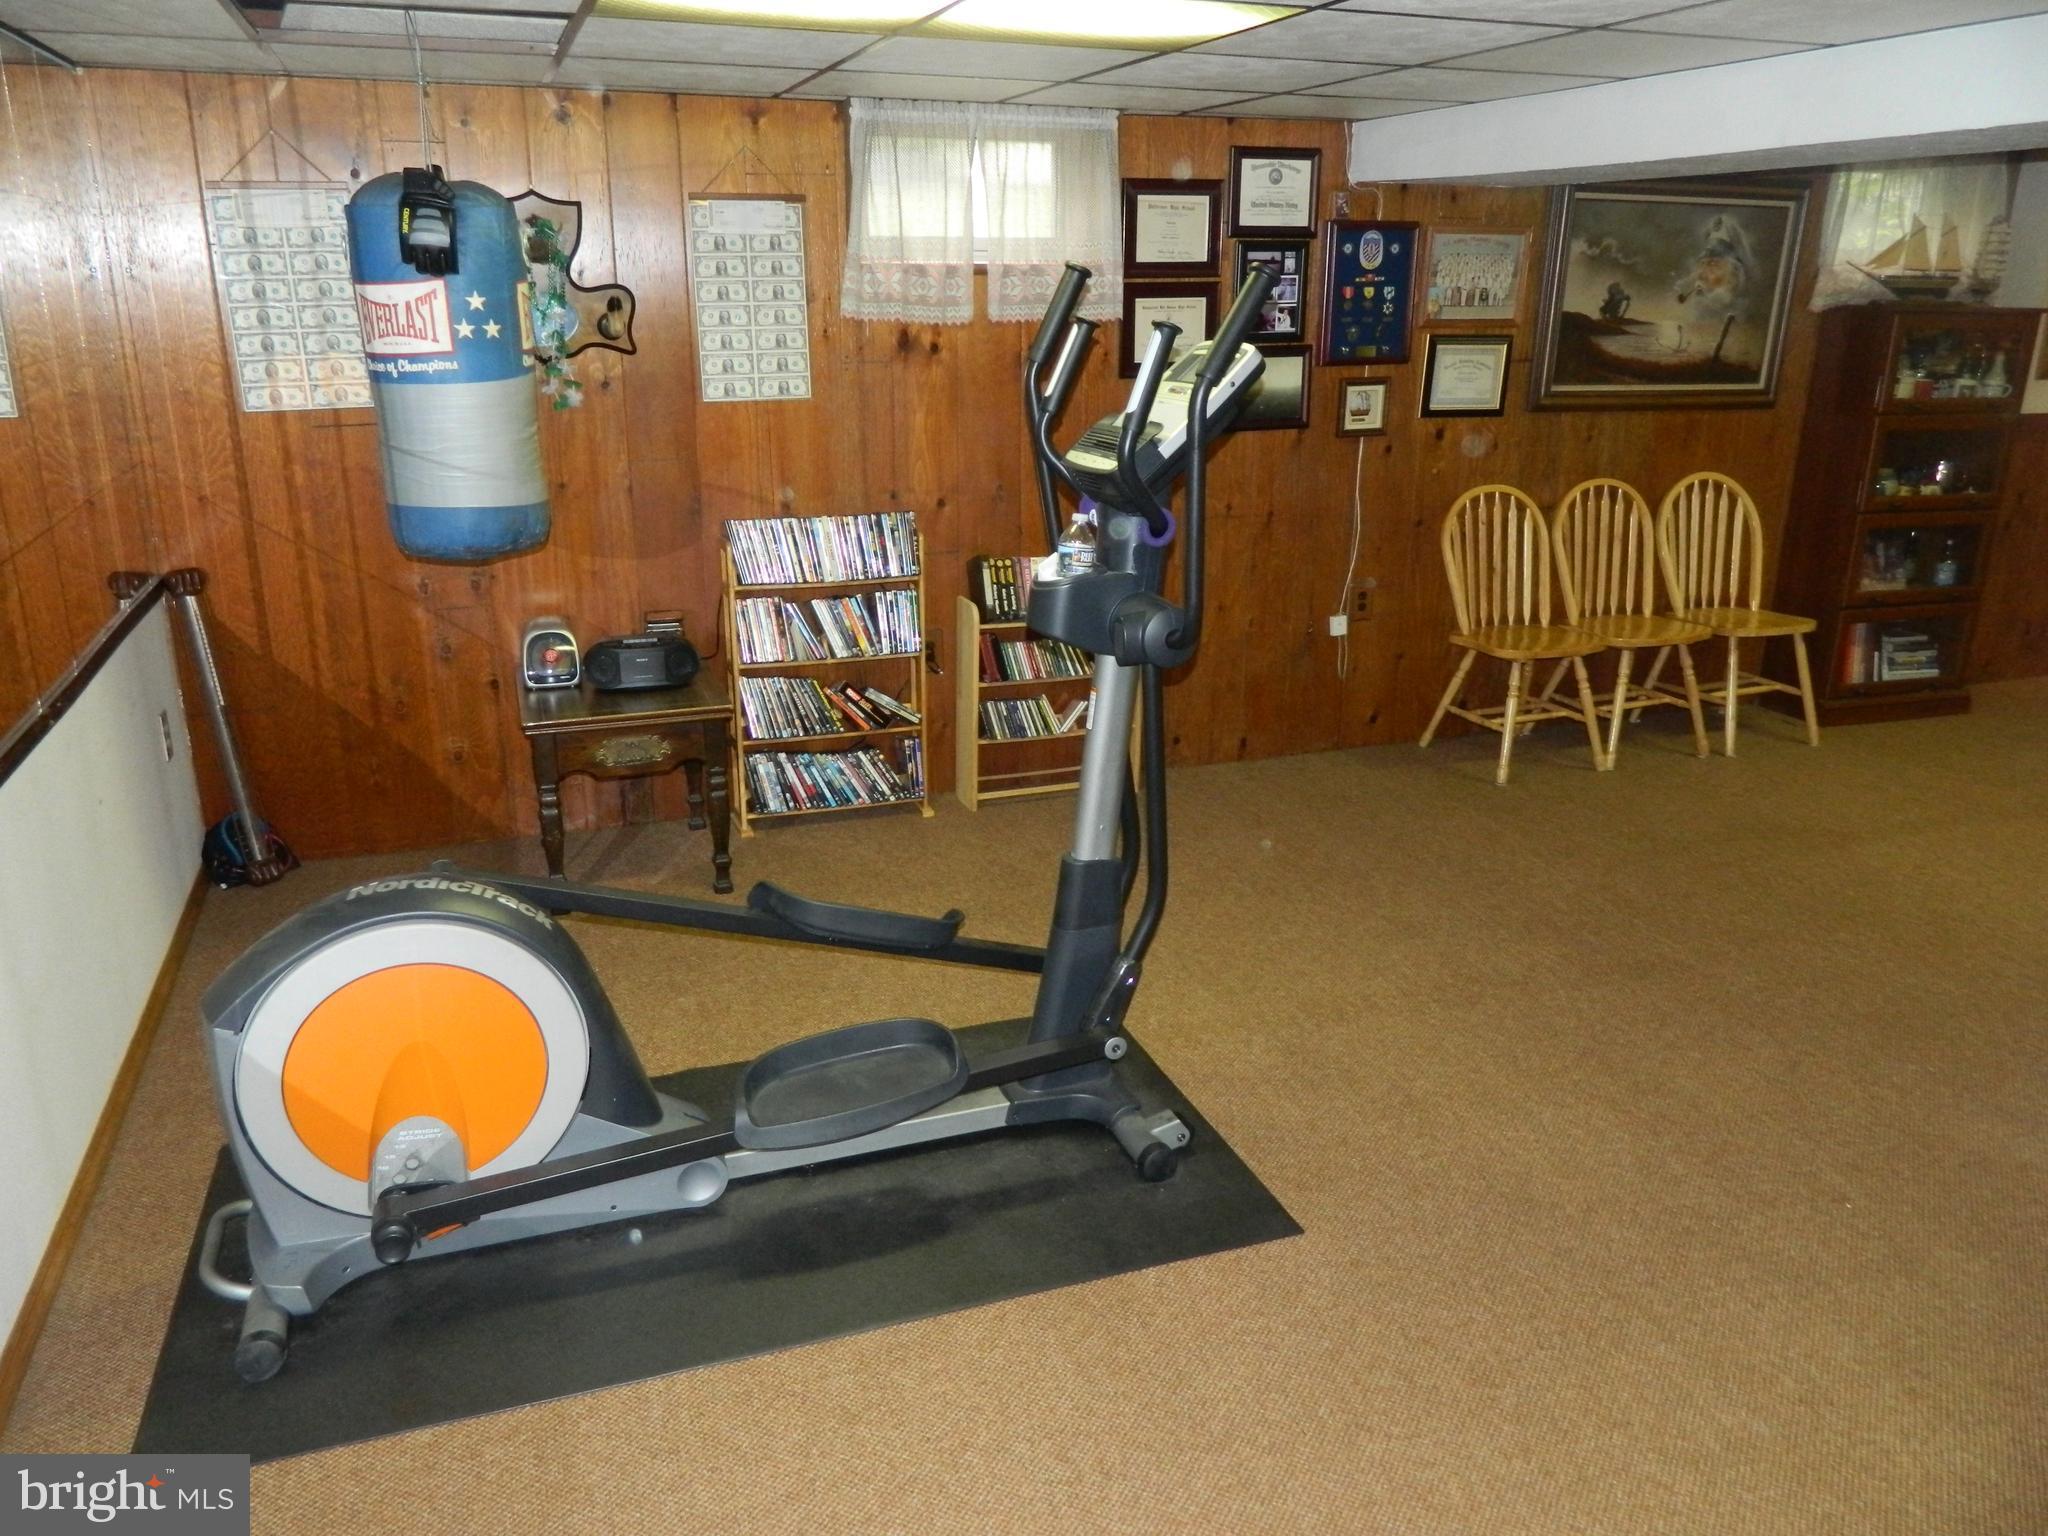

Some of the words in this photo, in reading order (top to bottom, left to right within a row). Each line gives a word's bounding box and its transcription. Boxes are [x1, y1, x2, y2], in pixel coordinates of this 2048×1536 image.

[359, 288, 440, 345] EVERLAST
[387, 361, 398, 378] of
[398, 359, 459, 374] Champions
[346, 877, 553, 930] NordicTrack
